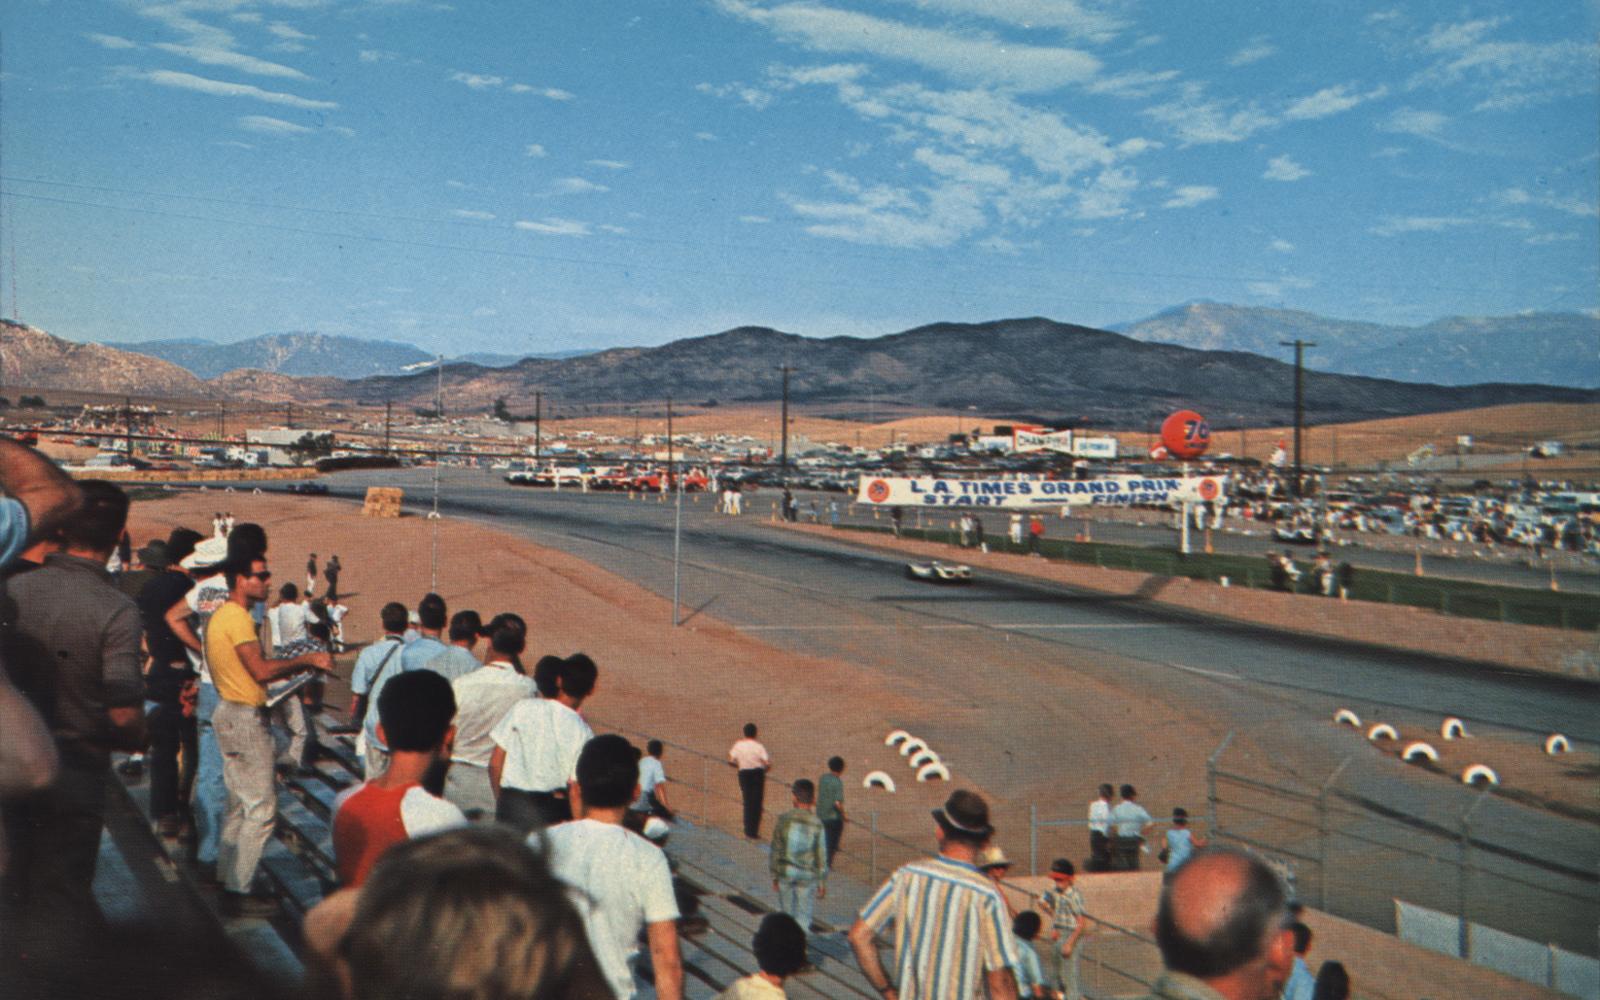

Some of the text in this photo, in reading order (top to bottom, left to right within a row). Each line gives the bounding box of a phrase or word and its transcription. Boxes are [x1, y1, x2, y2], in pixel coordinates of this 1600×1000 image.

[1184, 420, 1209, 440] 76
[959, 481, 1032, 494] TIMES
[1041, 480, 1120, 494] GRAND
[1128, 478, 1180, 491] PRIX
[924, 494, 1007, 505] START
